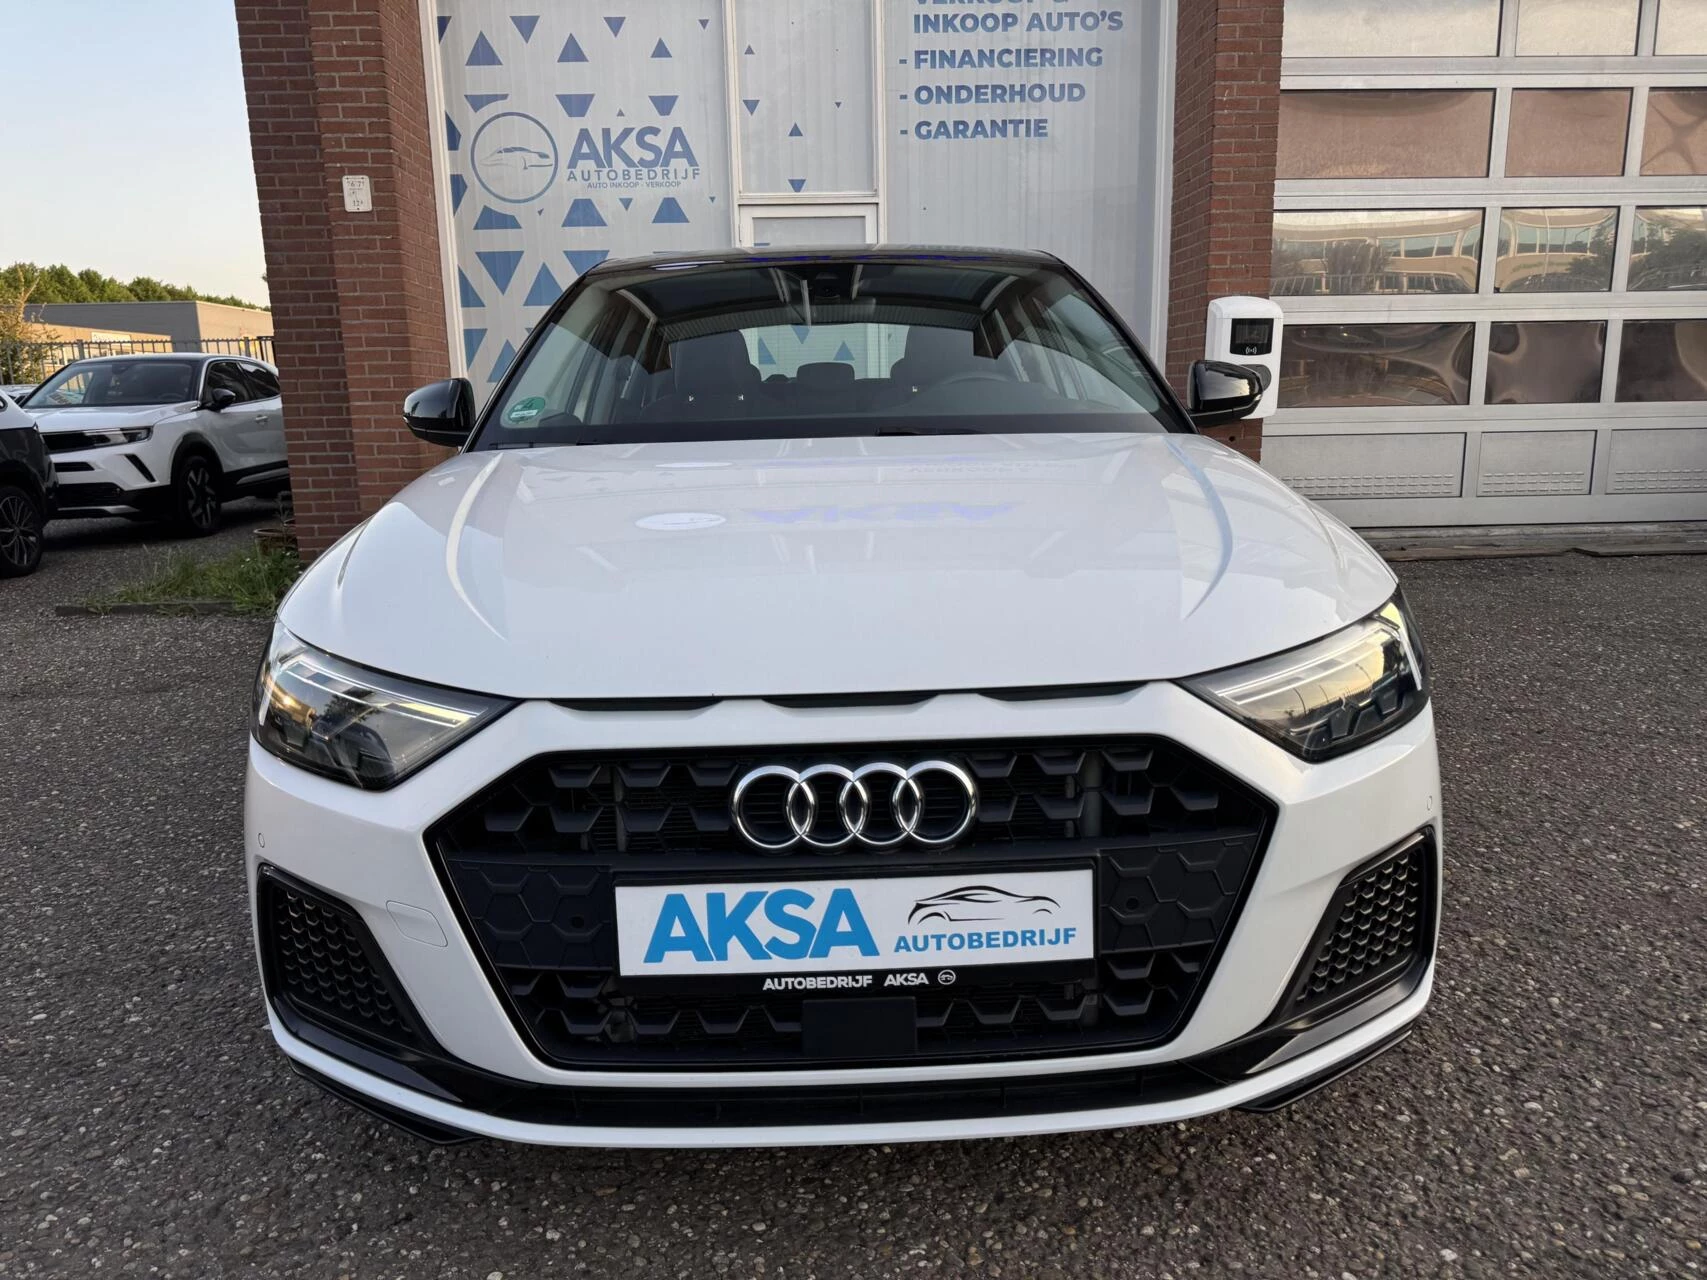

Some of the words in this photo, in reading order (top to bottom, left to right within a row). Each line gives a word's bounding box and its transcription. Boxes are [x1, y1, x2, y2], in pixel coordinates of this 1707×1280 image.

[914, 13, 1018, 33] INKOOP
[914, 47, 1103, 69] FINANCIERING
[914, 83, 1086, 104] ONDERHOUD
[914, 118, 1048, 140] GARANTIE
[567, 126, 699, 169] AKSA
[567, 168, 700, 181] AUTOBEDRIJF
[609, 181, 640, 189] INKOOP
[643, 888, 880, 963] AKSA
[894, 926, 1077, 953] AUTOBEDRIJF
[763, 975, 873, 990] AUTOBEDRIJF
[883, 972, 929, 987] AKSA
